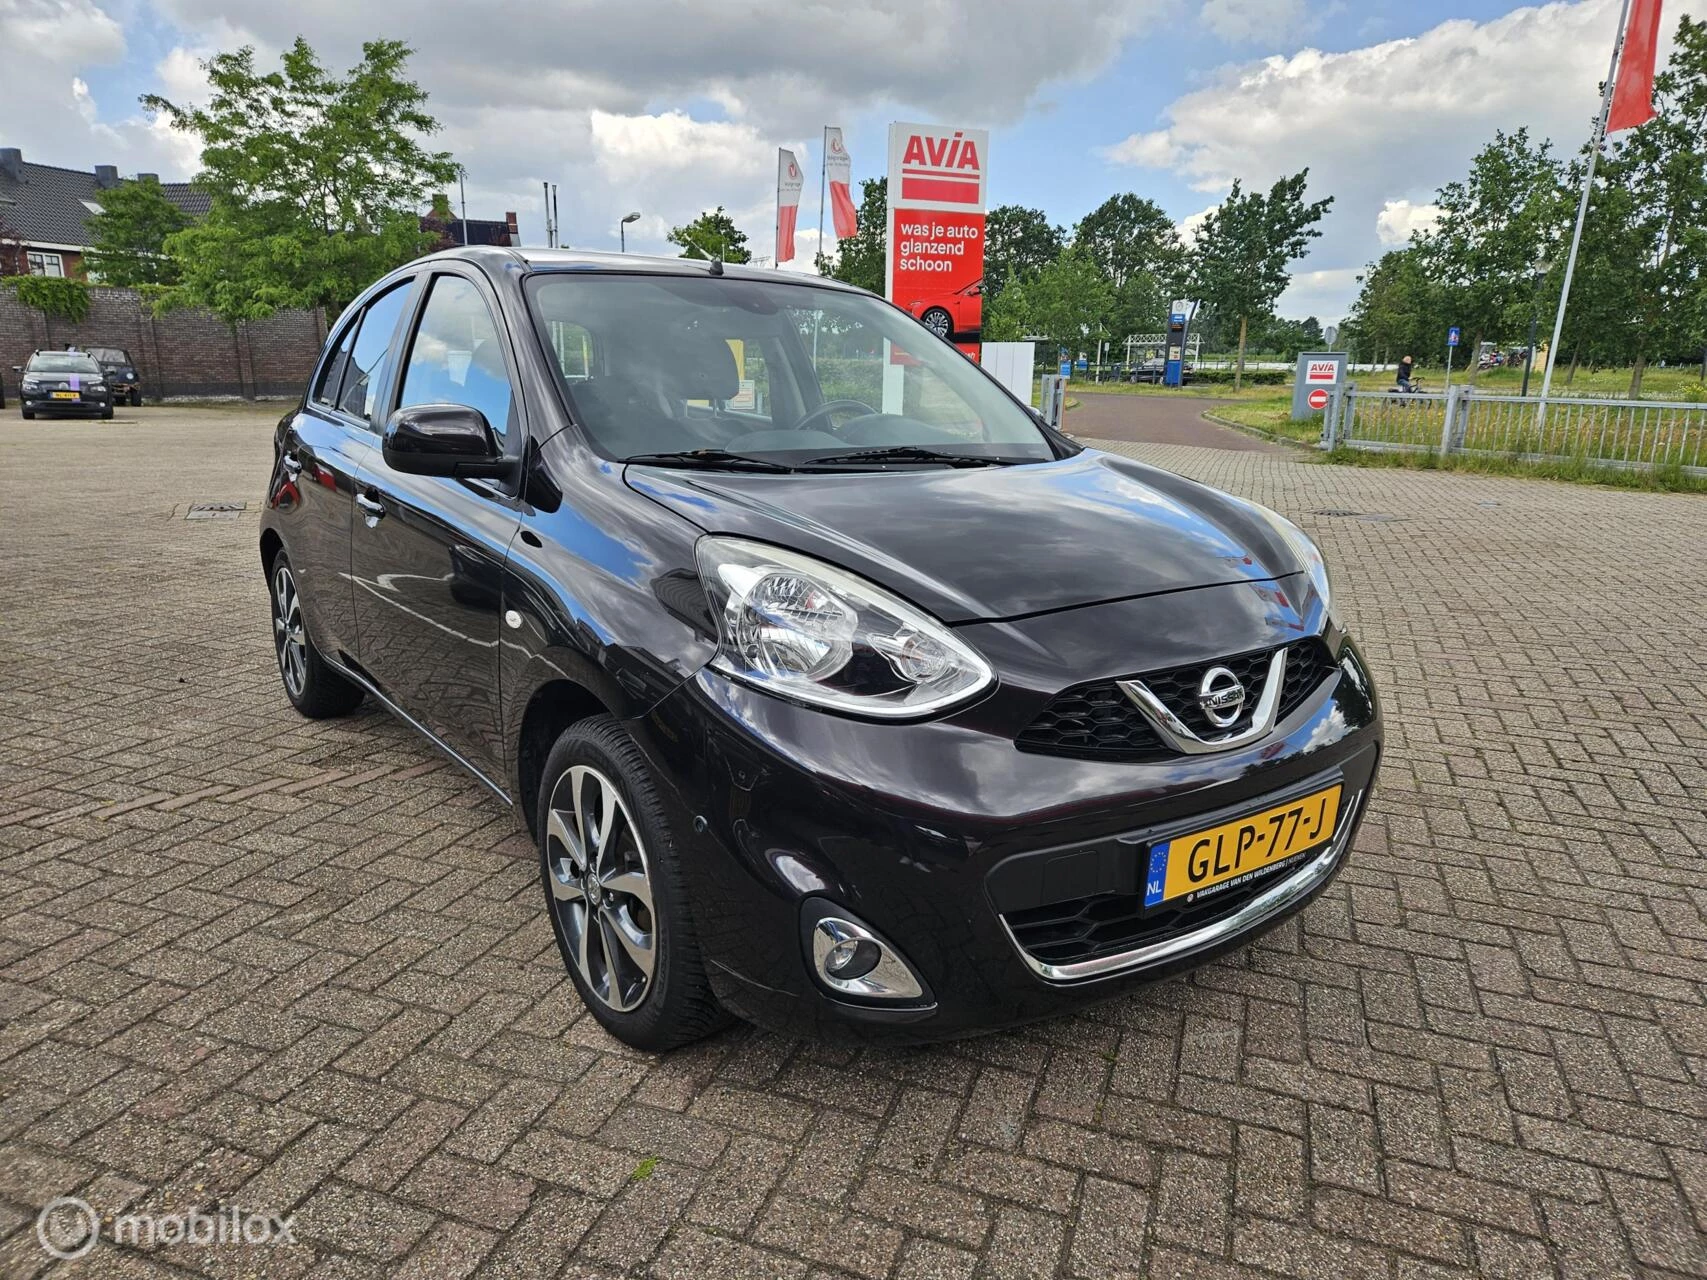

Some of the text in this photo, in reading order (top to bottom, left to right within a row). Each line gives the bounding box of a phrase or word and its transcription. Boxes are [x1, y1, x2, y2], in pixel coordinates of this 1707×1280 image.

[900, 222, 978, 240] was je auto
[900, 238, 964, 256] glanzend
[899, 255, 952, 271] schoon
[1208, 688, 1244, 705] NISSAN
[1188, 798, 1327, 882] GLP-77-J
[1146, 880, 1162, 896] NL
[1230, 877, 1242, 887] VAN
[1242, 873, 1253, 882] DEN
